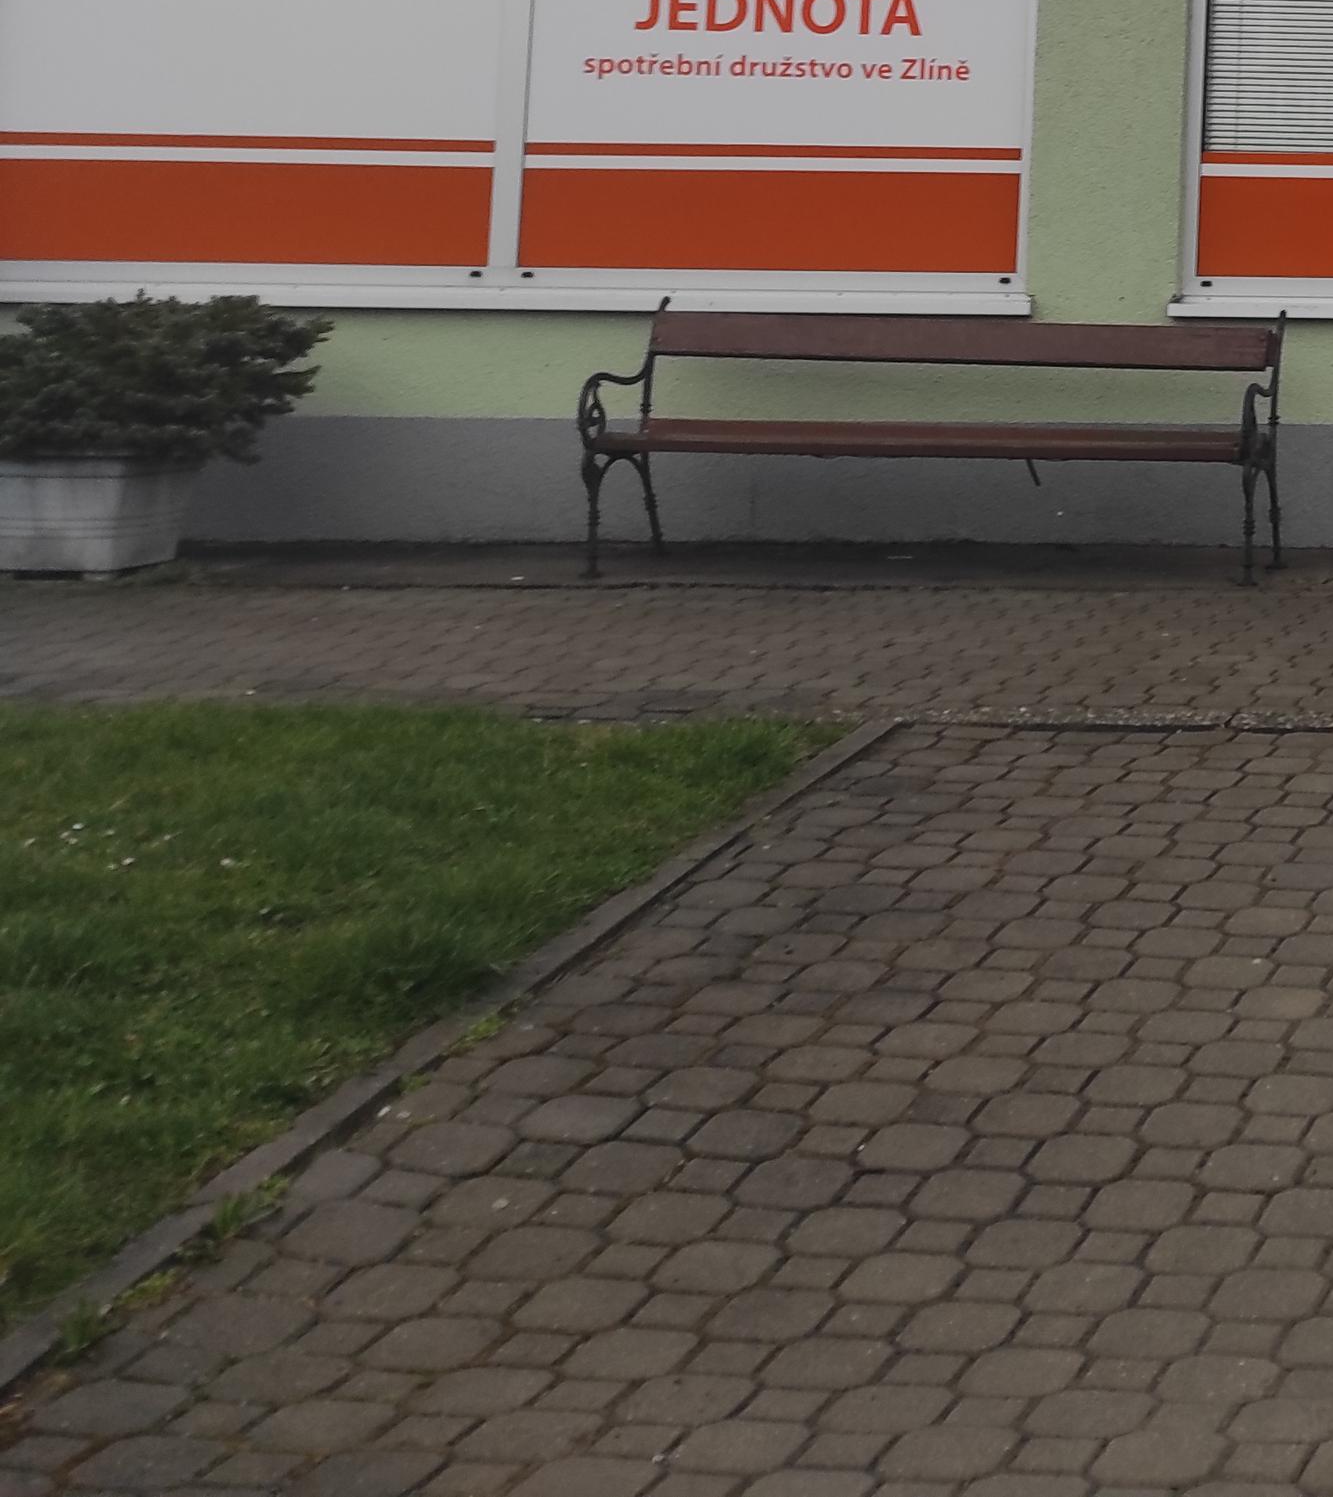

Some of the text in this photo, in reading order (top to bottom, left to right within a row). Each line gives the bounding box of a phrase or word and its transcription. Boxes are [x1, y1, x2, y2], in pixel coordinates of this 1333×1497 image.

[584, 53, 970, 81] spotřební družstvo ve Zlíně
